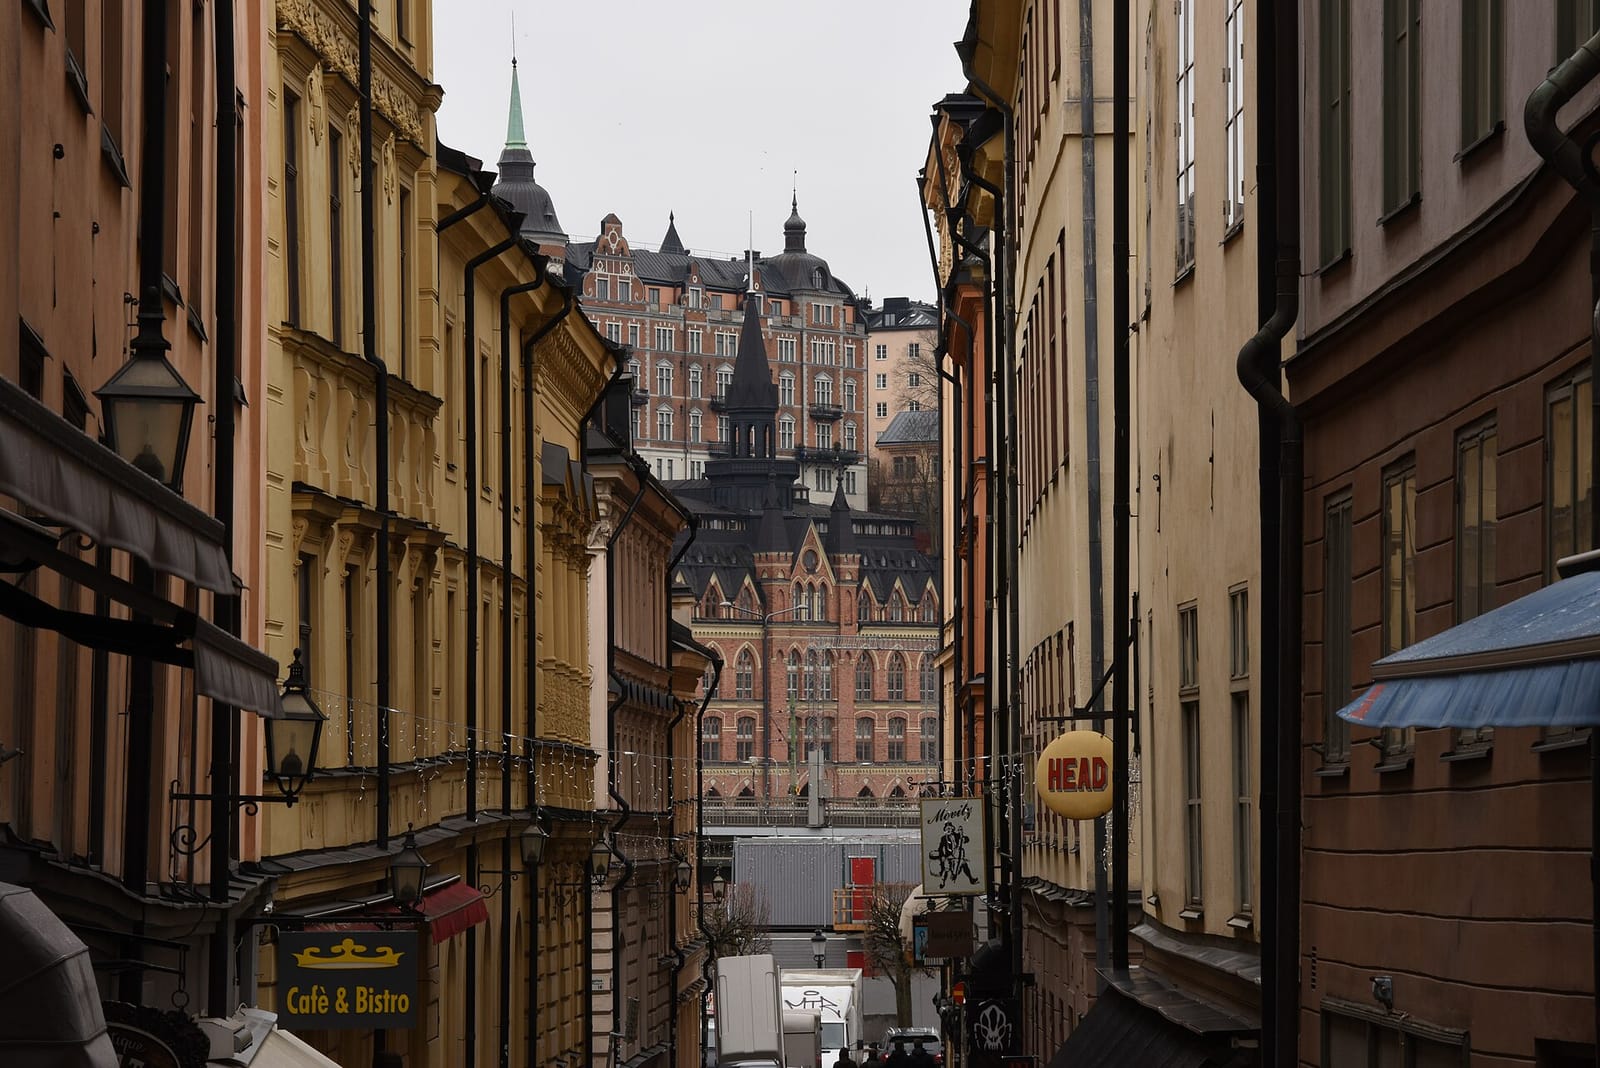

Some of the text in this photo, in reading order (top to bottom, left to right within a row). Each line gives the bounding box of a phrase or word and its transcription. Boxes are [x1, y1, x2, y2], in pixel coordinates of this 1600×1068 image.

[1048, 757, 1108, 792] HEAD
[287, 984, 410, 1014] Cafè & Bistro
